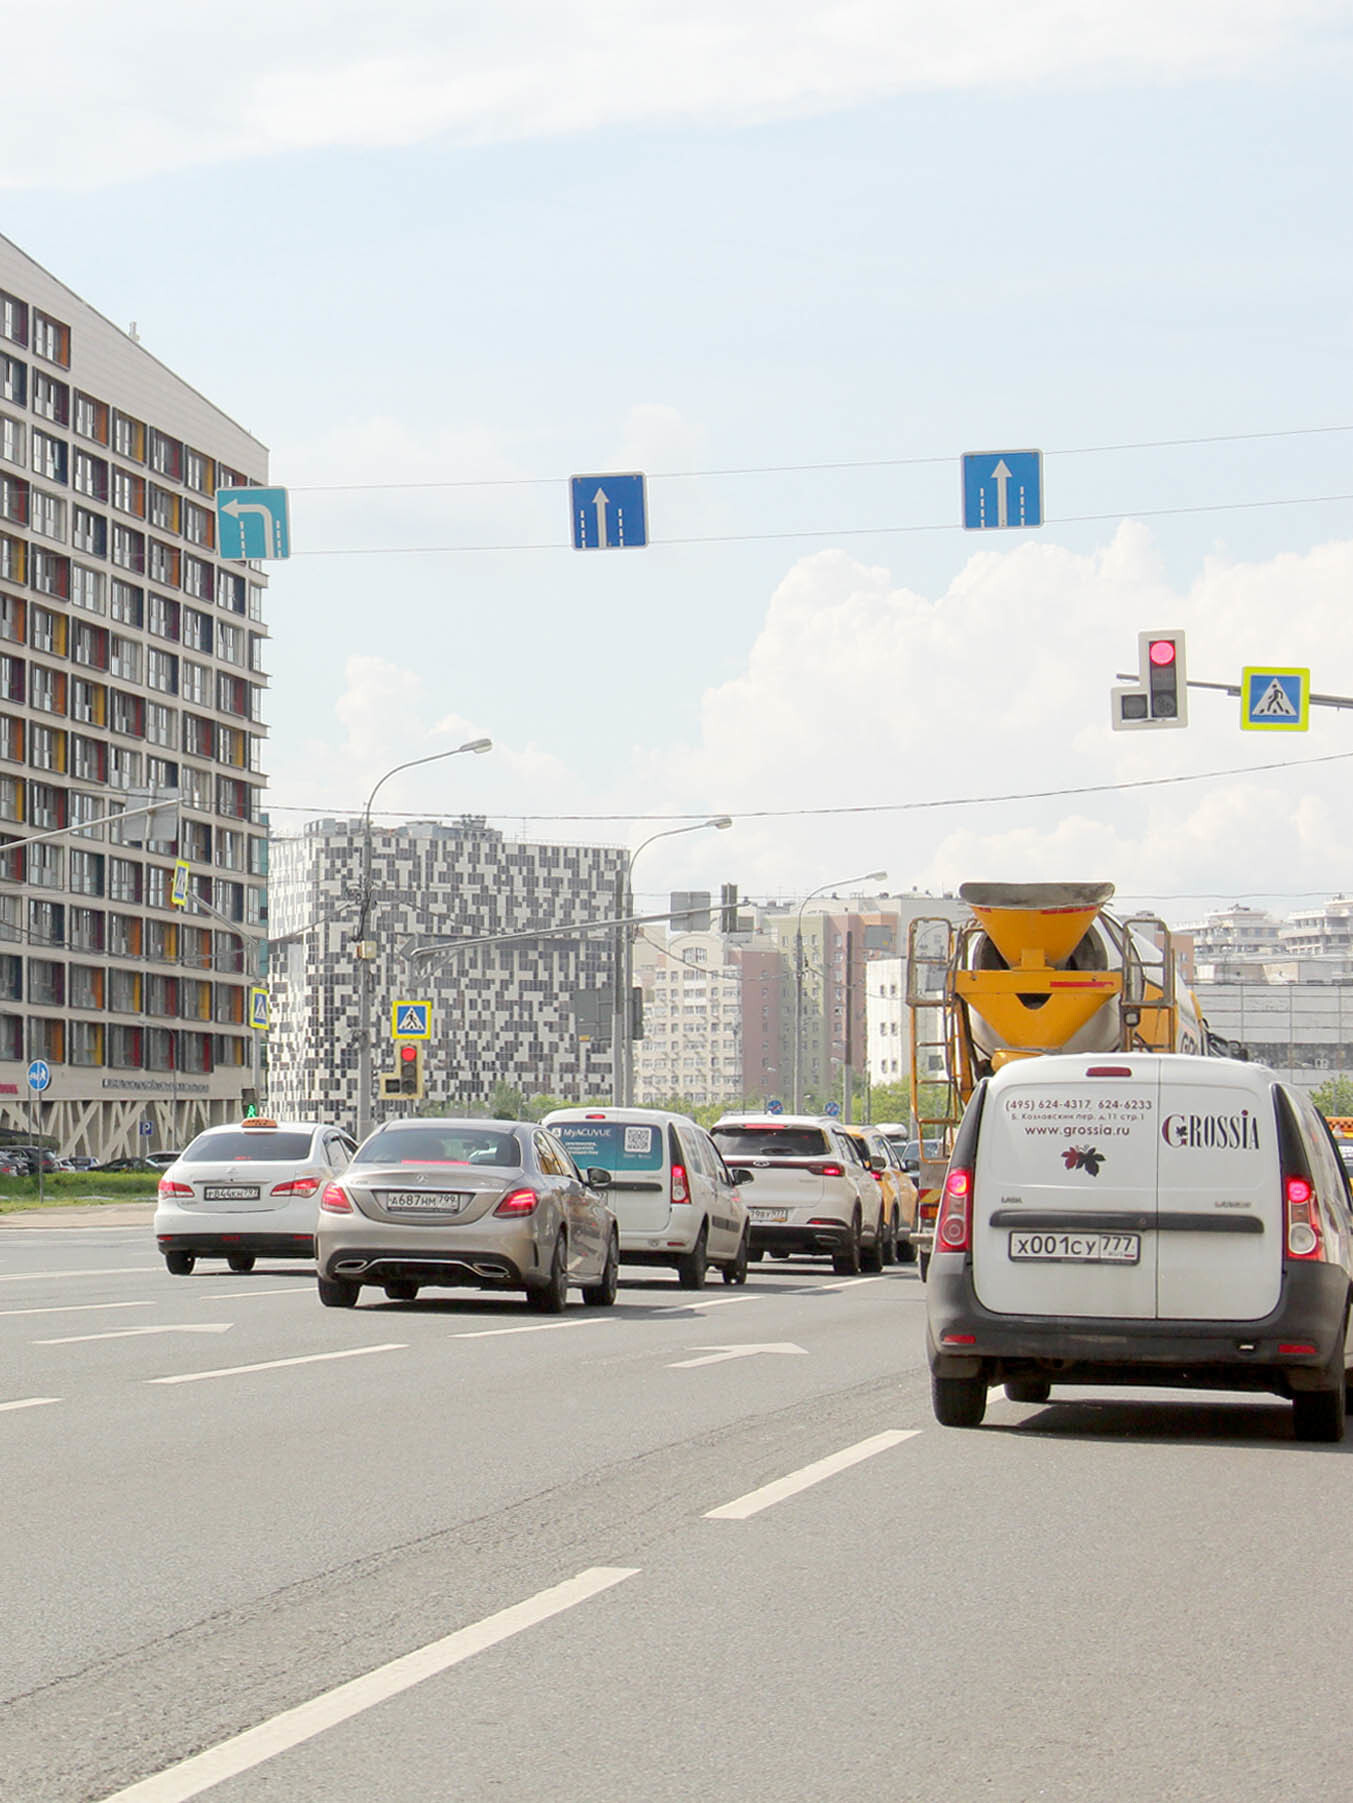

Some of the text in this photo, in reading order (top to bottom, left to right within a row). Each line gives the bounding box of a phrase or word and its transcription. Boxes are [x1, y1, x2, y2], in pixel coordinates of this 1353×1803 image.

[1005, 1100, 1035, 1112] (495)
[1098, 1100, 1152, 1110] 624-6233
[1025, 1124, 1130, 1138] www.grossia.ru
[1017, 1236, 1133, 1255] Х001СУ 777
